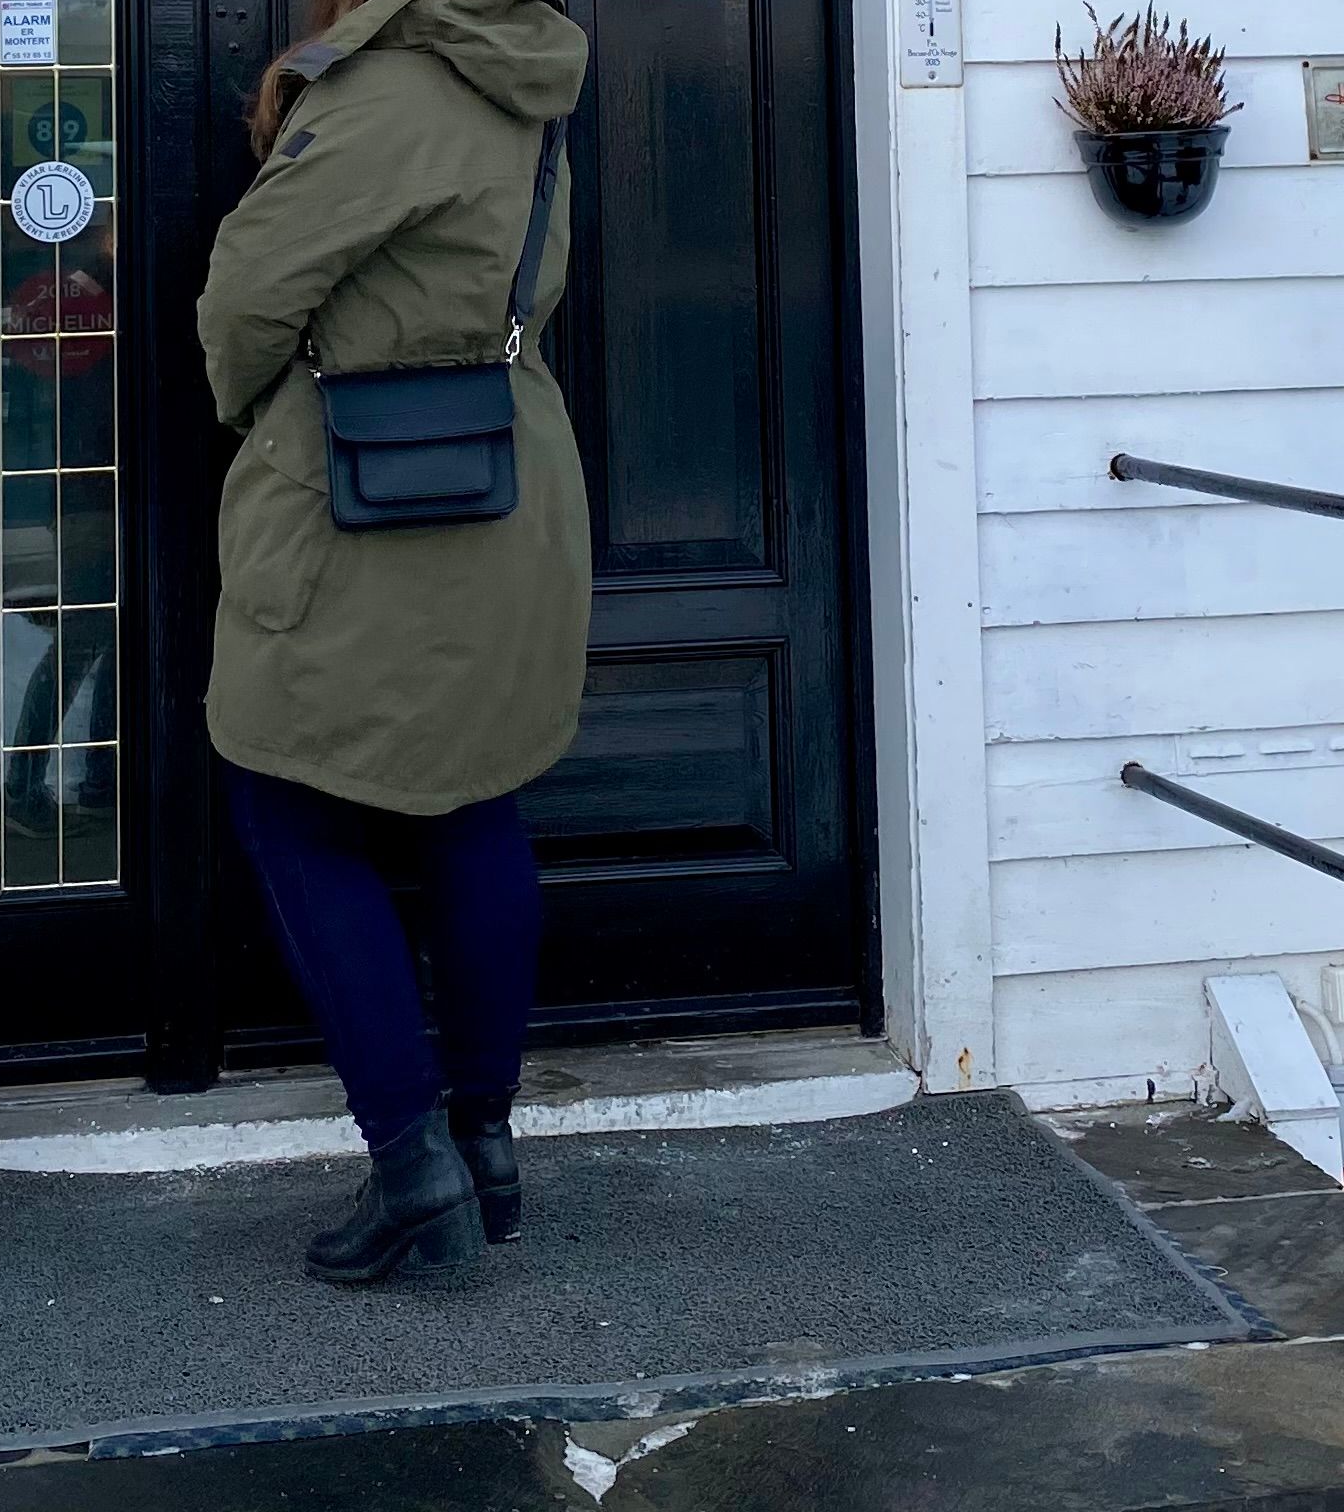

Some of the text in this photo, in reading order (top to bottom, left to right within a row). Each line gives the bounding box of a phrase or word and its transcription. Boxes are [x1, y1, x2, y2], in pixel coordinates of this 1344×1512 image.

[4, 15, 51, 26] ALARM
[21, 28, 34, 36] ER
[5, 38, 51, 46] MONTERT
[19, 164, 87, 188] VI HAR LÆRLING
[14, 196, 92, 240] GODKJENT LÆREBEDRIFT
